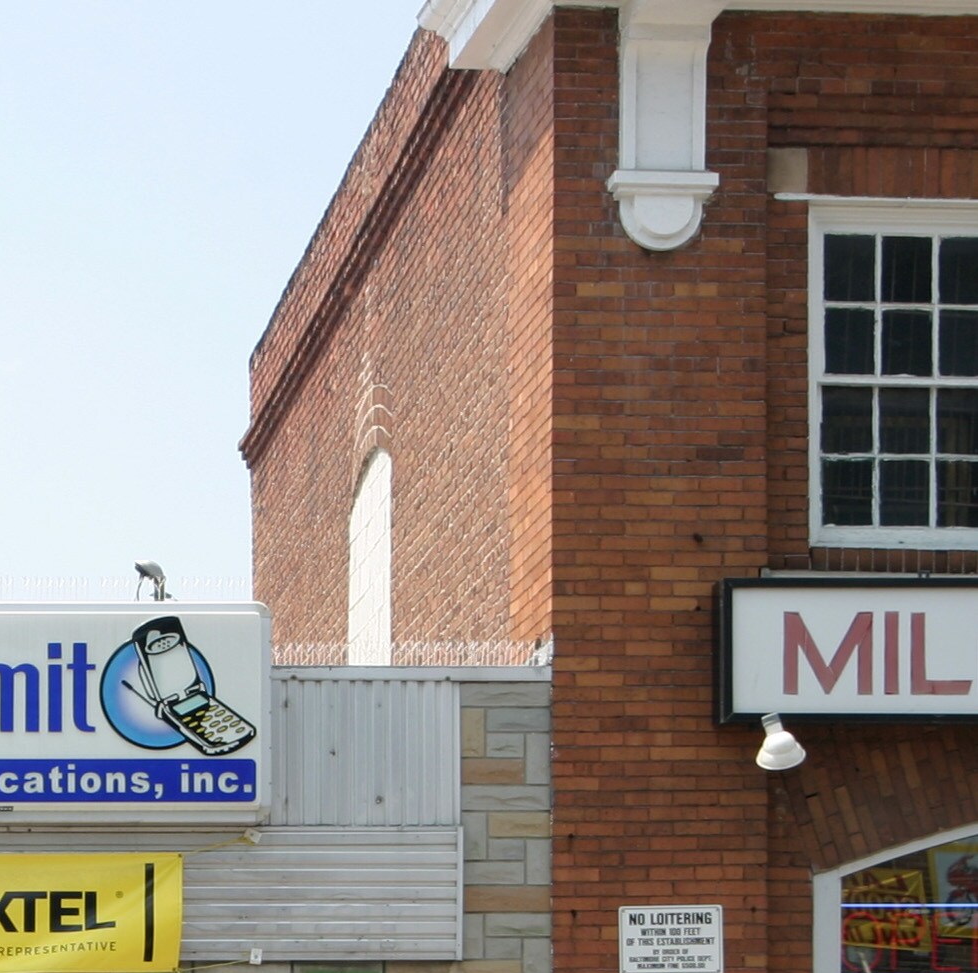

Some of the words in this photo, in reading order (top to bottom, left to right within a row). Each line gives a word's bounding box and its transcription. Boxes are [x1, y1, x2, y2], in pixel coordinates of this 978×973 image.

[783, 611, 973, 696] MIL
[181, 763, 253, 793] inc.
[628, 913, 645, 926] NO
[650, 912, 712, 925] LOITERING
[638, 938, 654, 946] THIS
[657, 937, 715, 946] ESTABLISHMENT
[684, 927, 701, 936] FEET
[842, 912, 978, 972] OPE
